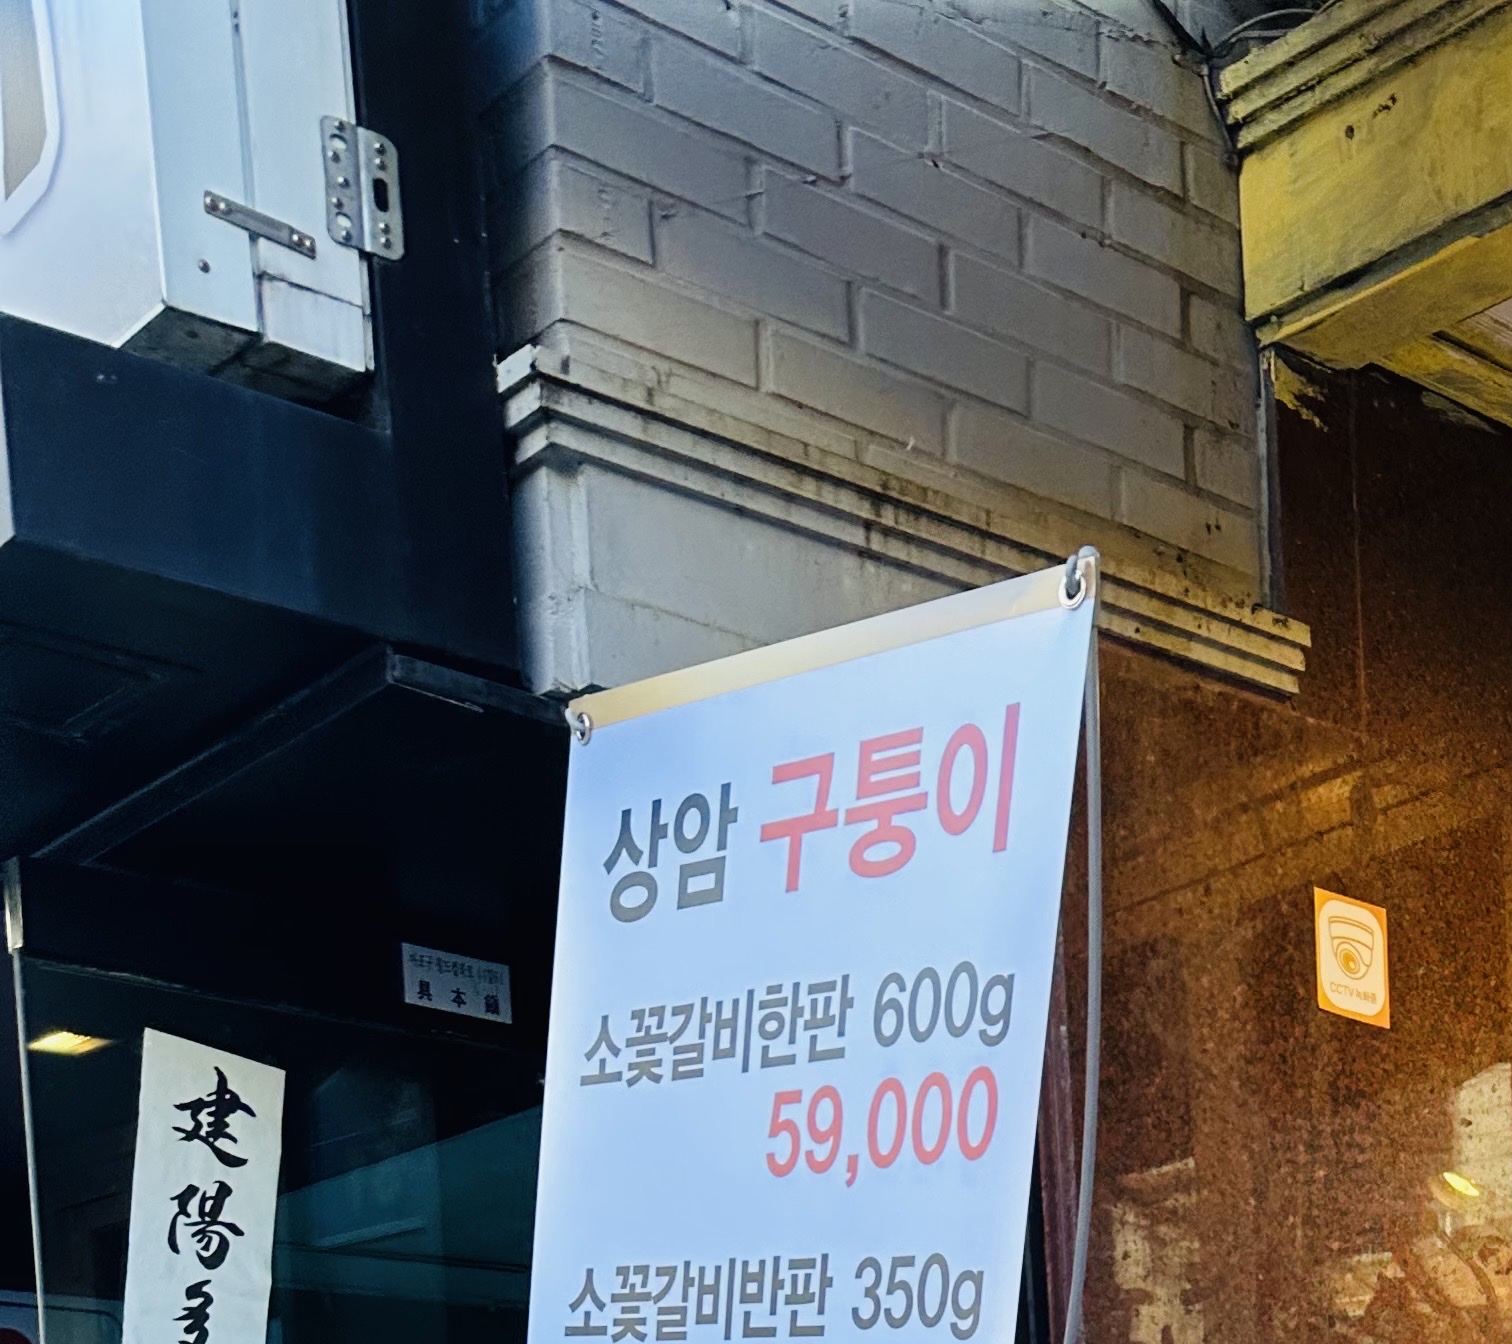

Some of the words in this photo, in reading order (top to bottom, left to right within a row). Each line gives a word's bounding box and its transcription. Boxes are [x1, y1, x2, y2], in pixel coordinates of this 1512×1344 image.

[603, 782, 738, 922] 상암
[760, 702, 1020, 893] 구퉁이
[580, 973, 853, 1086] 소꽃갈비한판
[873, 960, 1015, 1046] 600g
[766, 1066, 998, 1187] 59,000
[564, 1253, 832, 1344] 소꽃갈비반판
[852, 1253, 984, 1340] 350g
